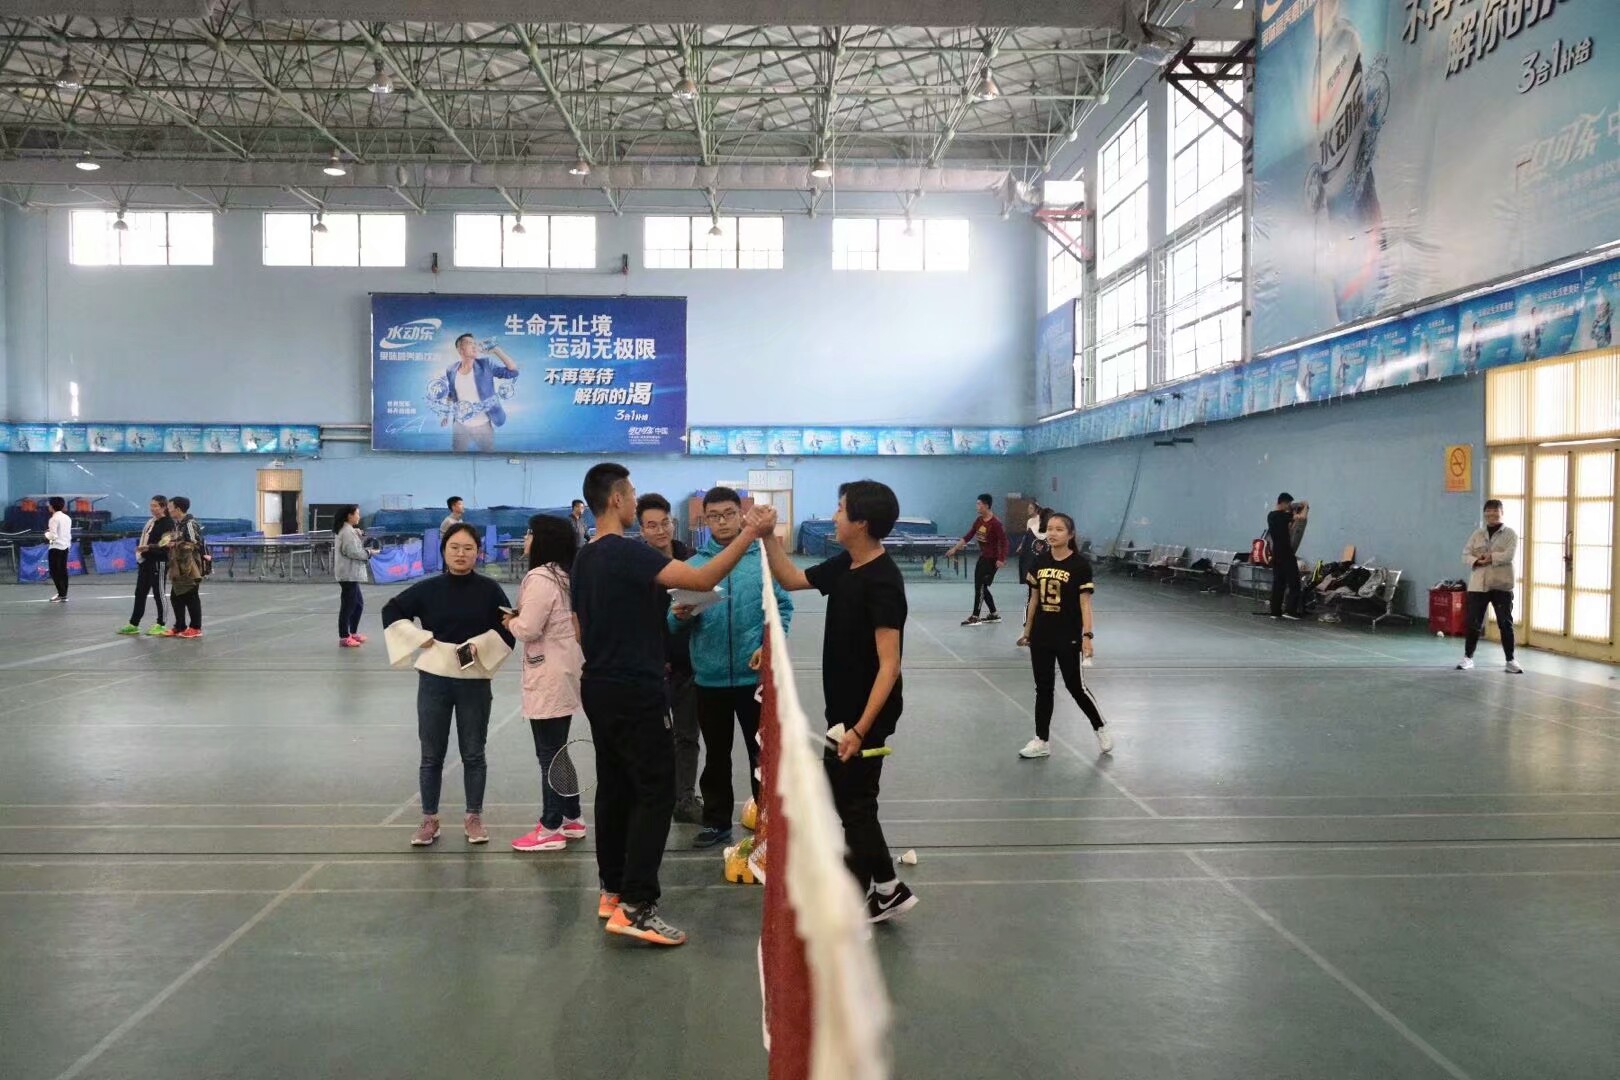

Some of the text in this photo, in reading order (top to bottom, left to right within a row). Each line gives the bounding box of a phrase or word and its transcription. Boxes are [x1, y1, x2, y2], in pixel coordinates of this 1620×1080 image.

[1445, 0, 1566, 80] 解你的
[1517, 36, 1592, 94] 3合1补给
[504, 313, 613, 337] 生命无止境
[548, 337, 656, 360] 运动无极限
[544, 367, 615, 385] 不再等待
[573, 382, 653, 405] 解你的渴
[1037, 567, 1070, 583] DICKIES
